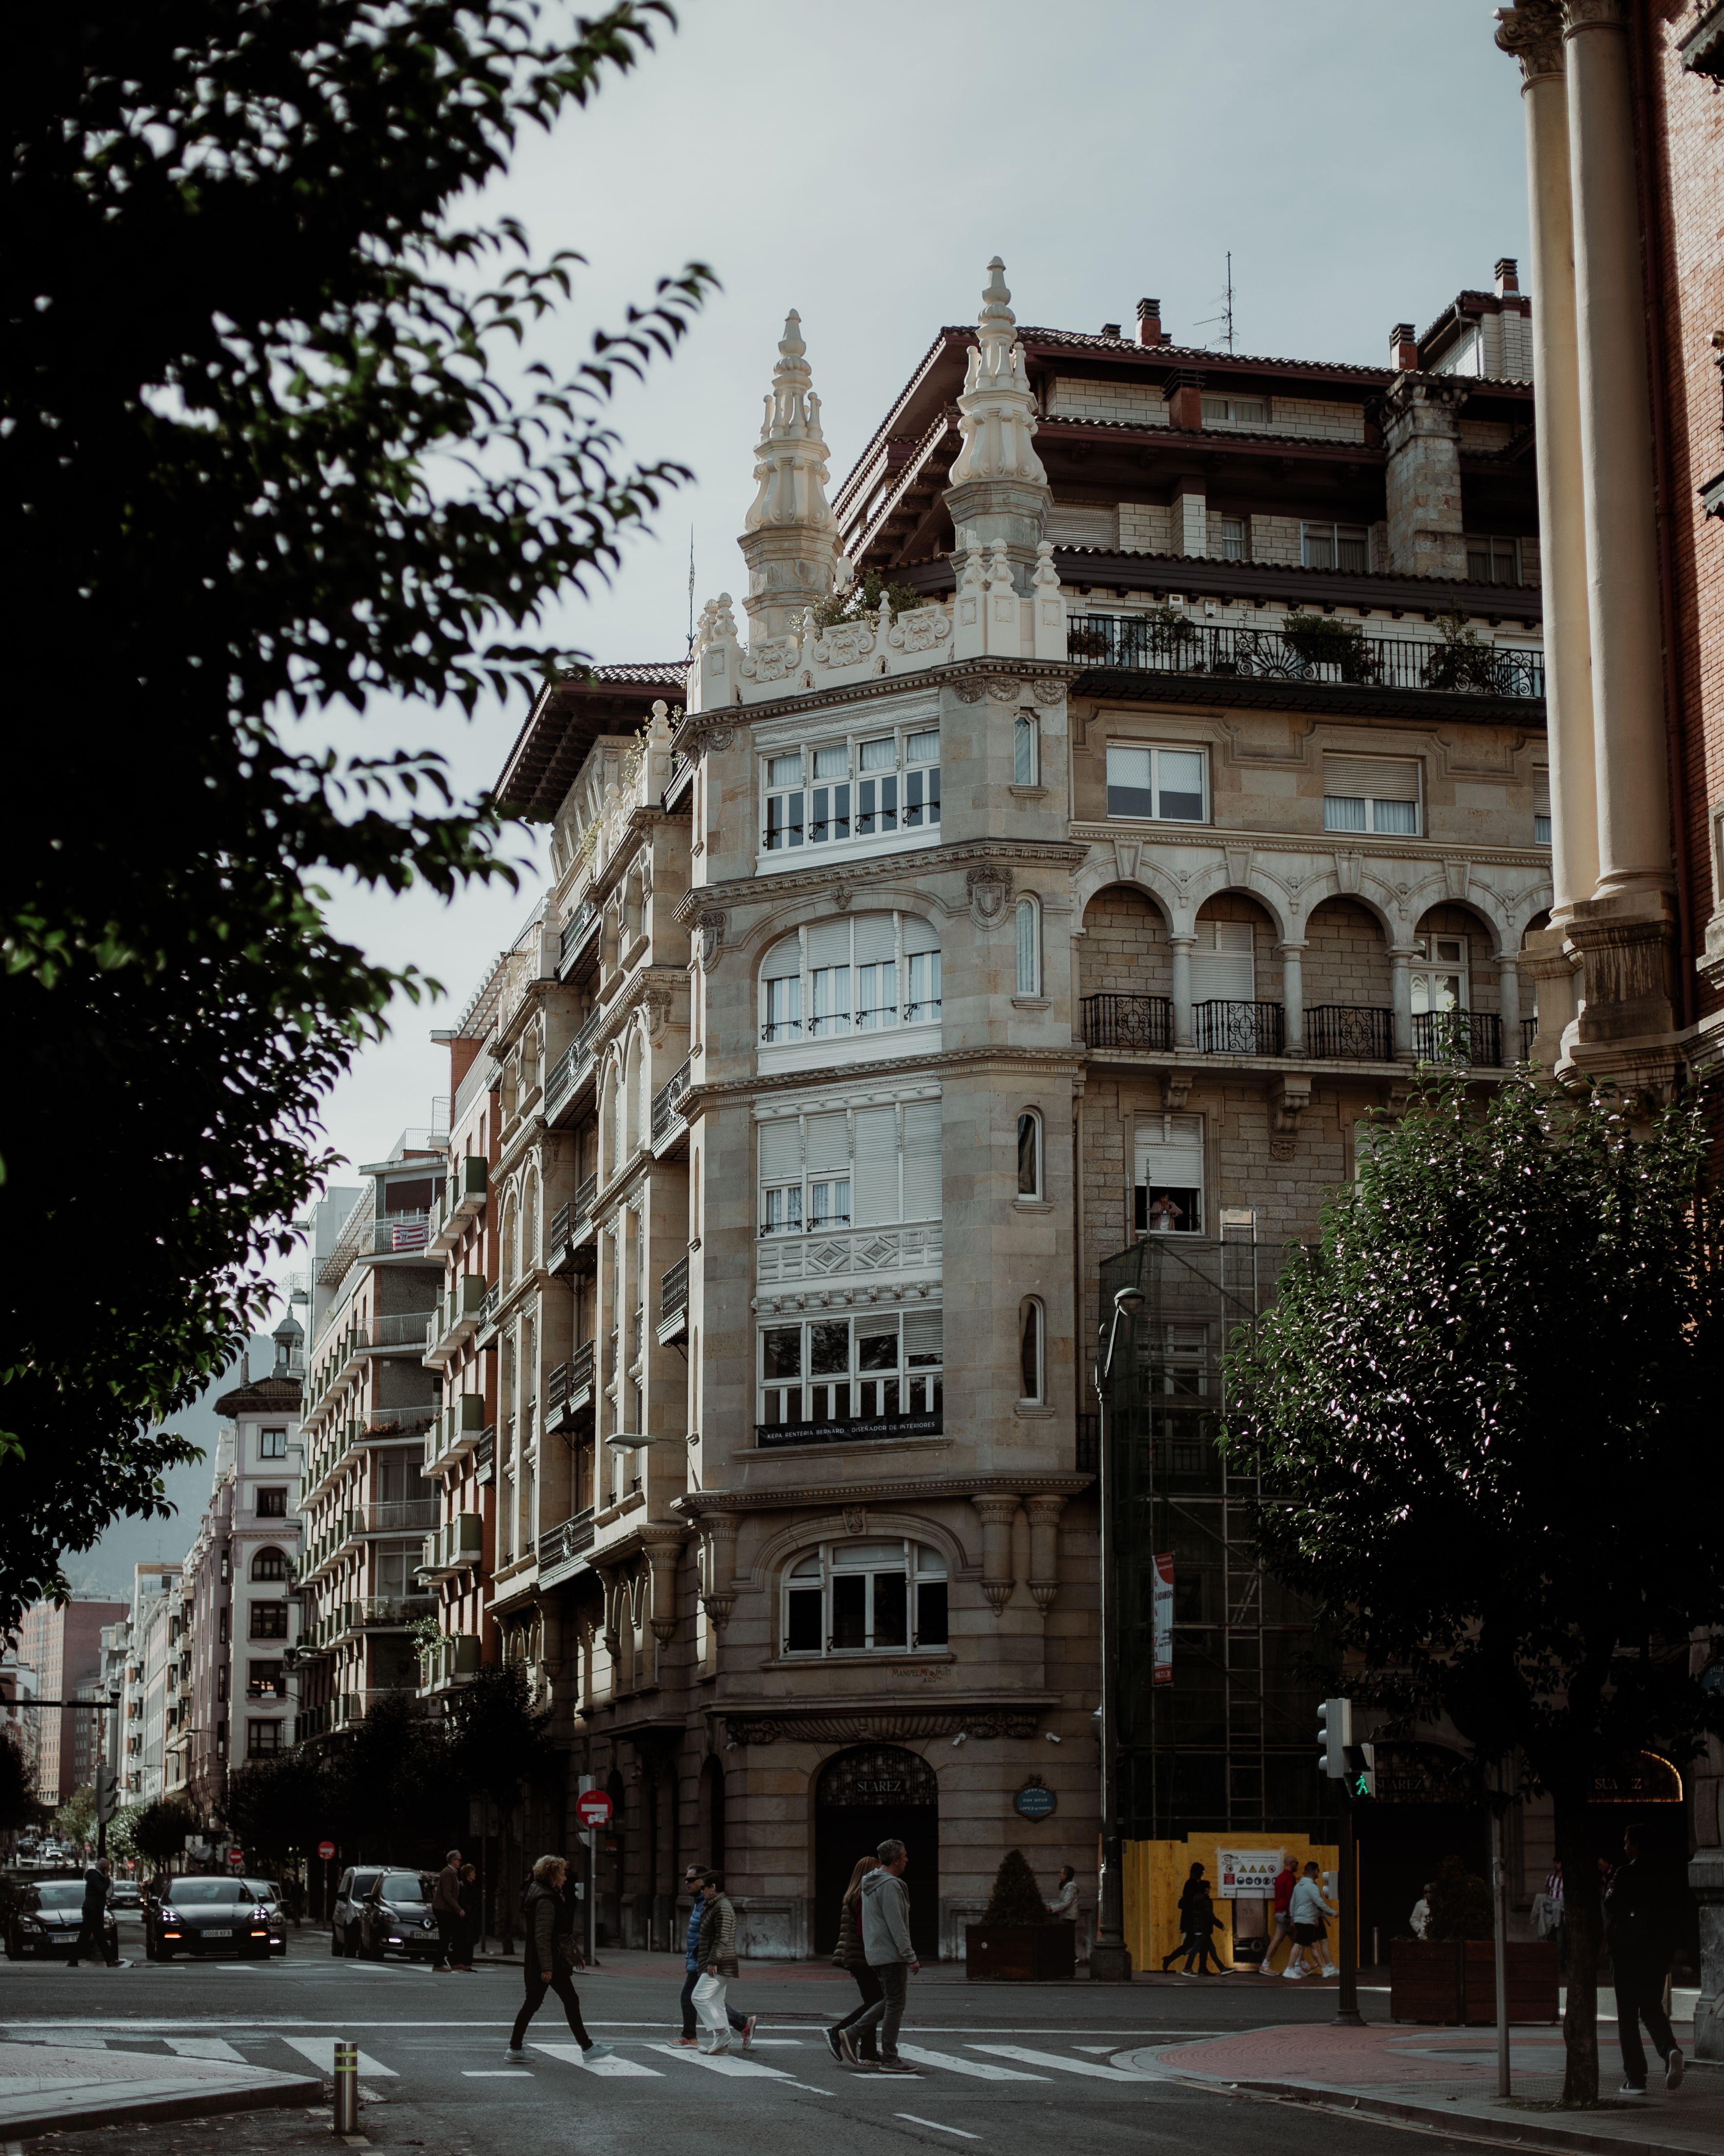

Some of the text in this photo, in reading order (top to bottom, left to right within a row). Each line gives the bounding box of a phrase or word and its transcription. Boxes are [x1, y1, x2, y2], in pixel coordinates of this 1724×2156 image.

[851, 1425, 887, 1433] DISEÑADOR
[900, 1421, 935, 1429] INTERIORES
[858, 1781, 901, 1792] SUAREZ
[1594, 1777, 1642, 1790] SUAZ
